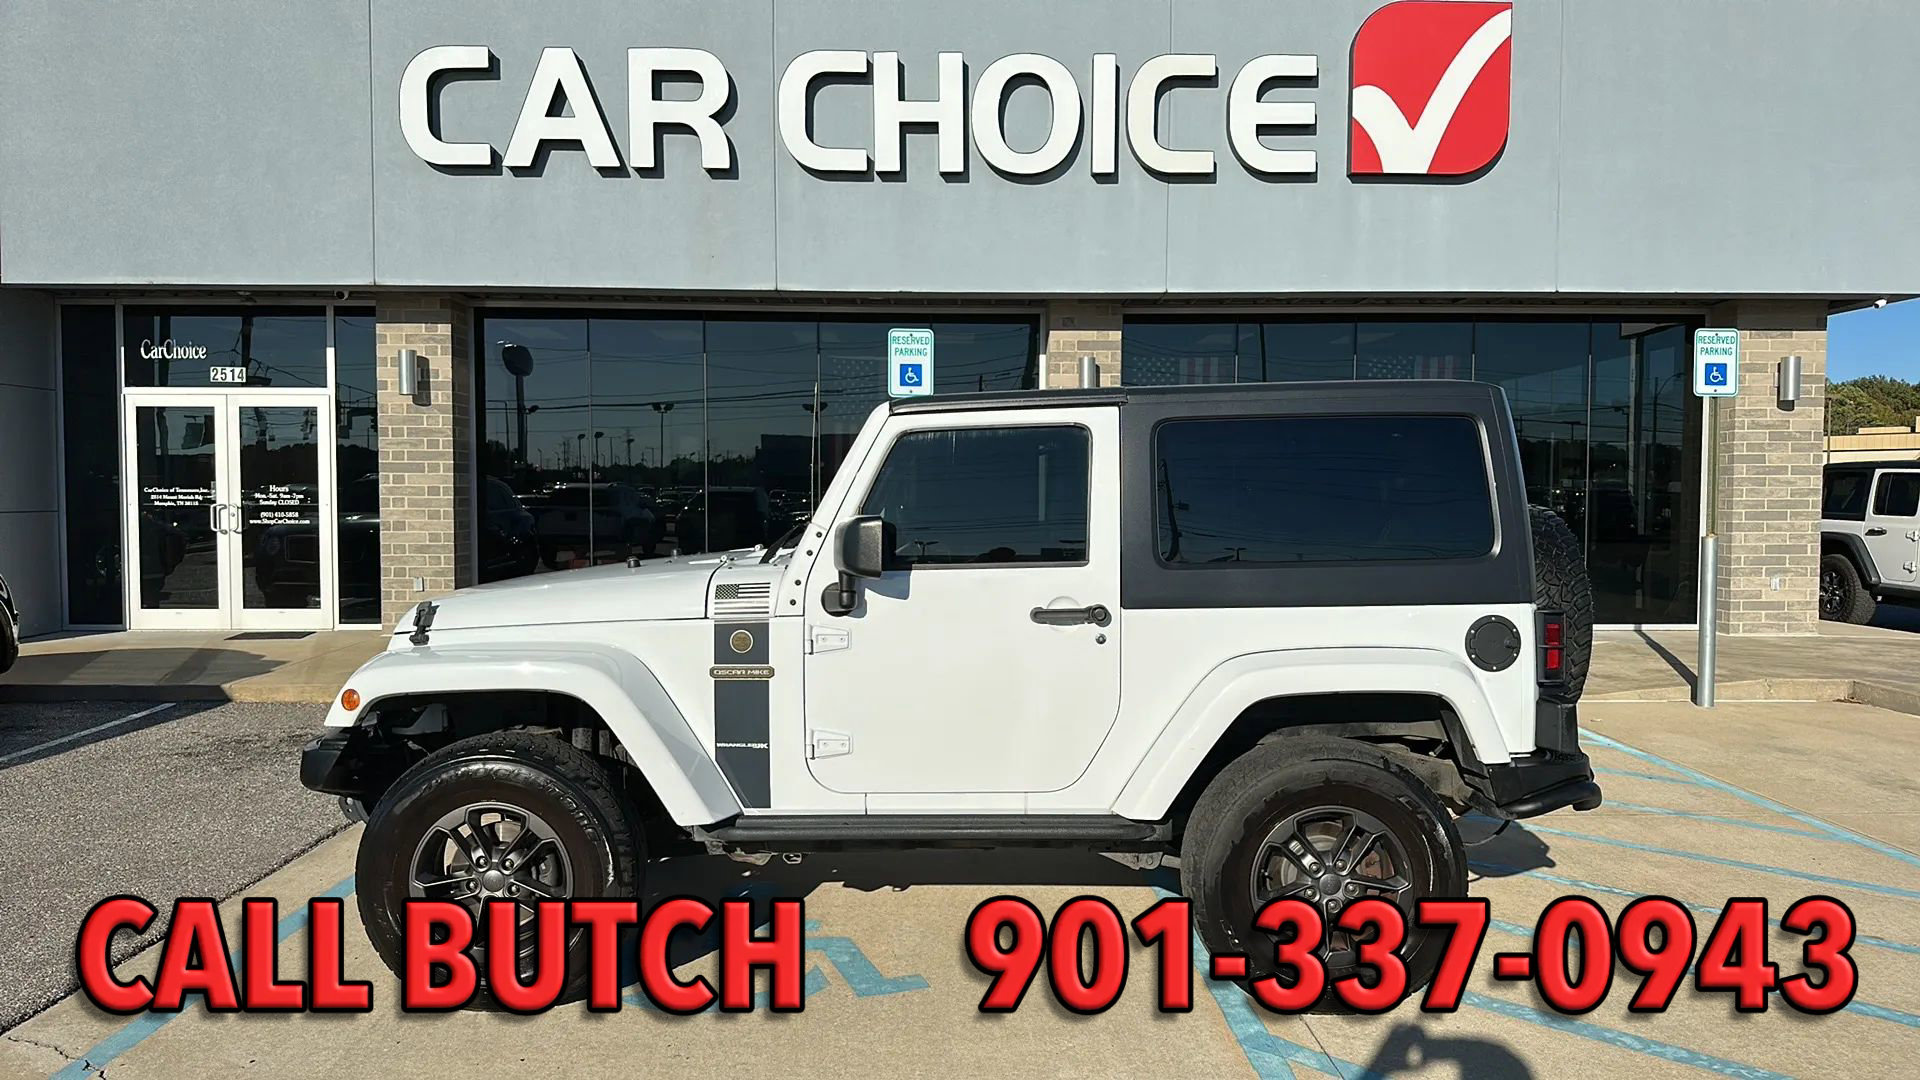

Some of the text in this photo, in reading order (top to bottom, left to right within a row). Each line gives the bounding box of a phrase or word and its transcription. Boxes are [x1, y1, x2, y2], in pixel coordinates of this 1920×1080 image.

[399, 45, 1318, 176] CAR CHOICE
[892, 336, 930, 345] RESERVED
[1698, 336, 1736, 345] RESERVED
[141, 339, 207, 359] CarChoice
[894, 347, 928, 356] PARKING
[1700, 346, 1733, 356] PARKING
[211, 367, 245, 381] 2514
[269, 484, 289, 492] Hours
